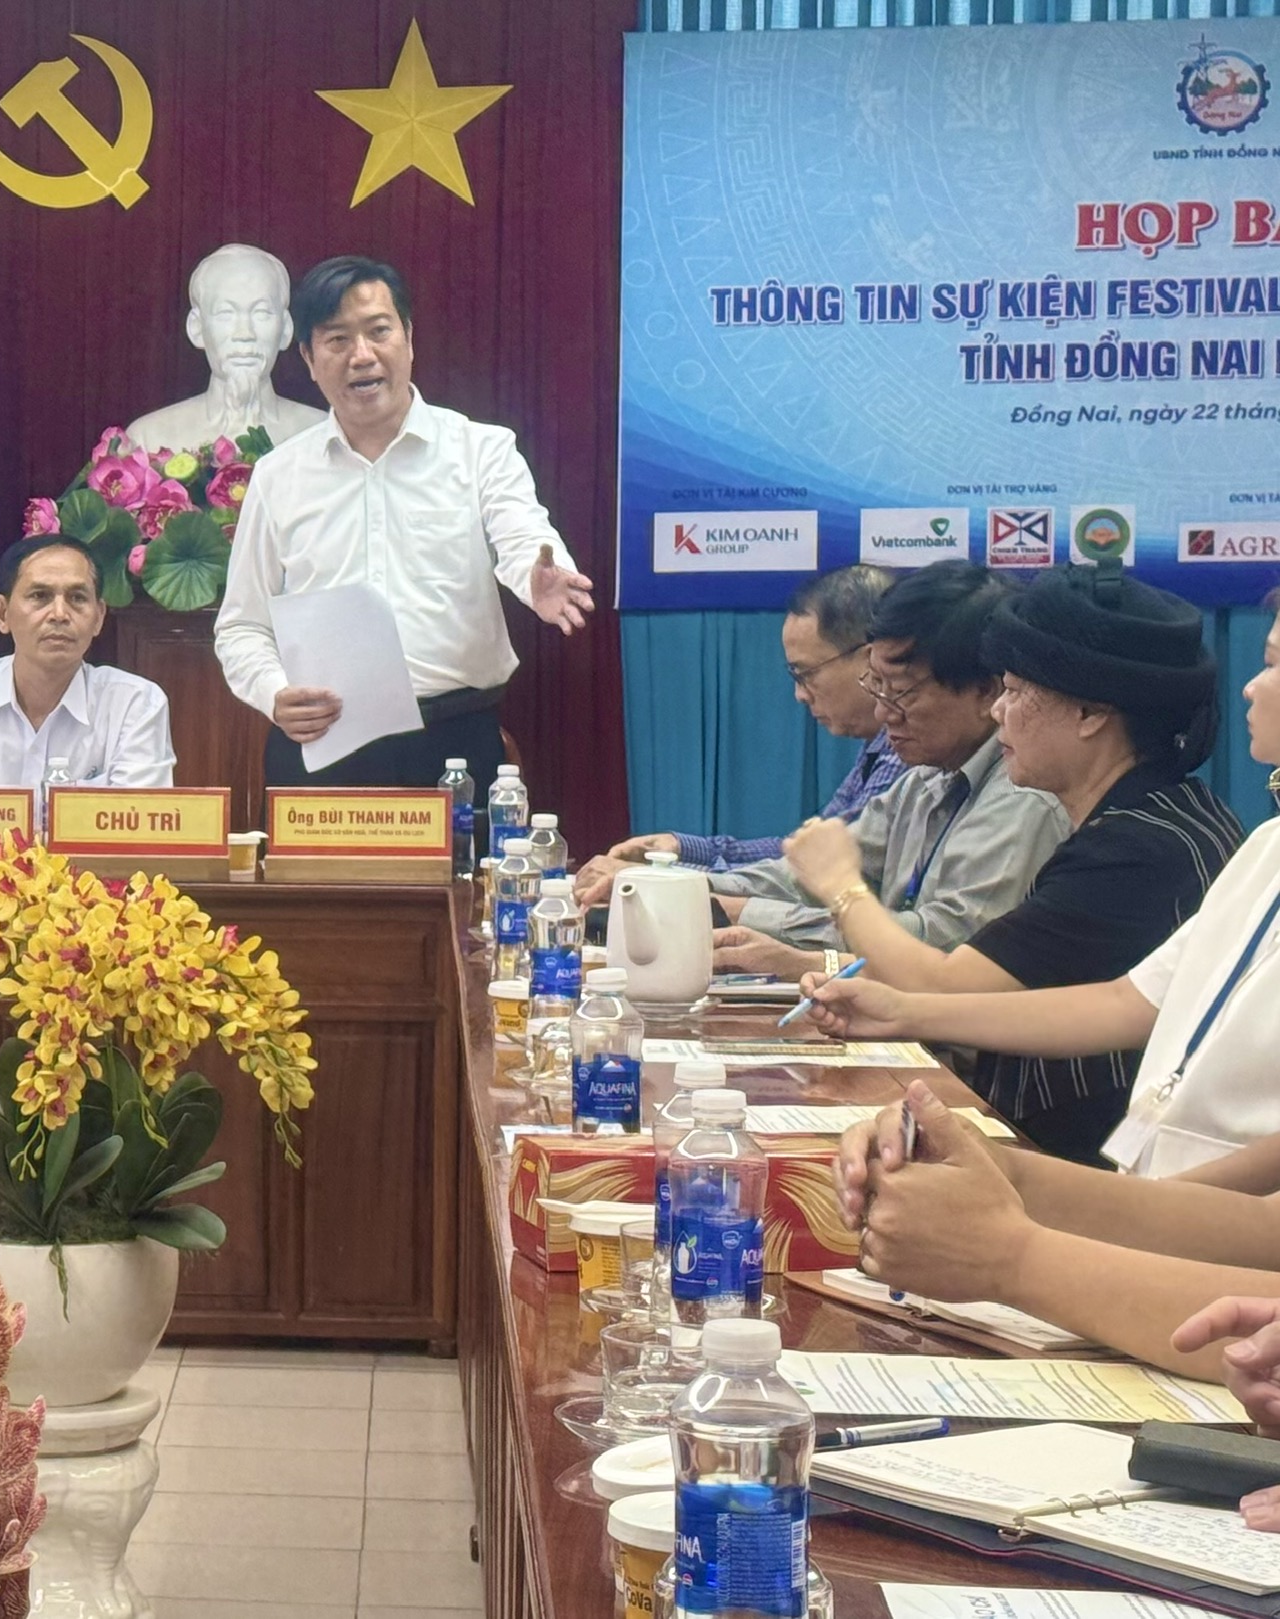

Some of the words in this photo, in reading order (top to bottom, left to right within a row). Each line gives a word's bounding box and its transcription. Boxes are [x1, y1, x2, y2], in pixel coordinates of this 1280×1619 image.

[1152, 149, 1189, 160] UBND
[1076, 201, 1217, 257] HỌP
[1233, 200, 1280, 245] B
[709, 278, 842, 324] THÔNG
[853, 283, 919, 321] TIN
[932, 279, 990, 328] SỰ
[998, 273, 1094, 325] KIỆN
[1107, 277, 1280, 317] FESTIVAL
[959, 332, 1053, 381] TỈNH
[1064, 330, 1177, 379] ĐỒNG
[1191, 339, 1262, 376] NAI
[1010, 403, 1072, 426] Đồng
[1077, 405, 1122, 423] Nai,
[1129, 403, 1188, 425] ngày
[1192, 403, 1219, 420] 22
[706, 528, 740, 542] KIM
[743, 527, 798, 541] OANH
[871, 535, 957, 548] Vietcombank
[706, 544, 749, 554] GROUP
[1220, 536, 1280, 557] AGR
[95, 806, 140, 831] CHỦ
[147, 808, 181, 831] TRÌ
[287, 807, 314, 826] Ông
[319, 808, 343, 824] BÙI
[348, 810, 395, 824] THANH
[399, 811, 432, 824] NAM
[588, 1081, 637, 1097] AQUAFINA
